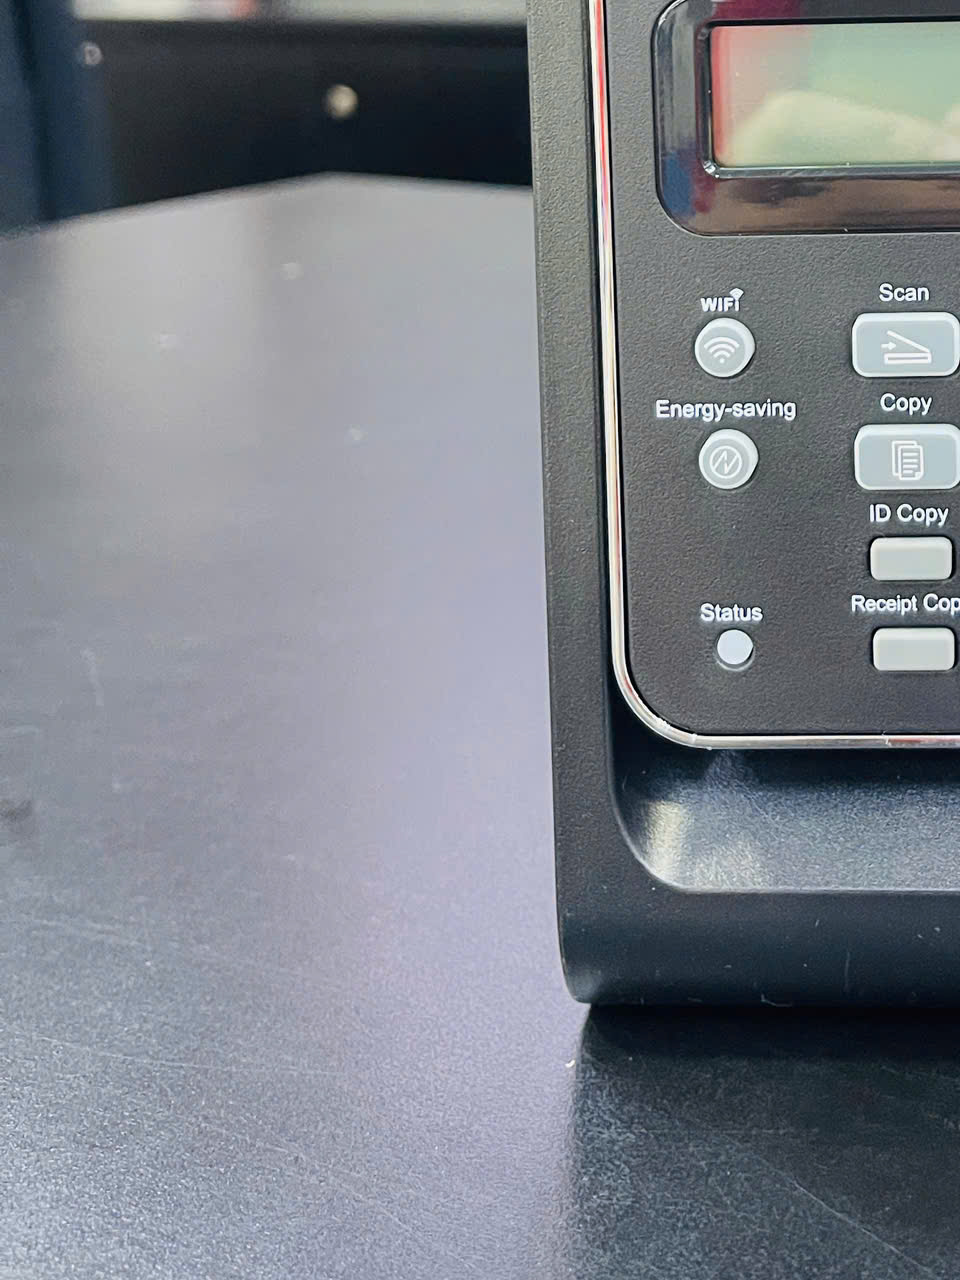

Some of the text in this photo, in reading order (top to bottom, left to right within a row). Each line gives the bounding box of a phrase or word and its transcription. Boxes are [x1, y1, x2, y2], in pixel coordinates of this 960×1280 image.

[879, 283, 930, 302] Scan
[655, 398, 797, 423] Energy-saving
[880, 393, 932, 416] Copy
[869, 503, 949, 527] ID Copy
[700, 602, 763, 622] Status
[851, 595, 917, 613] Receipt
